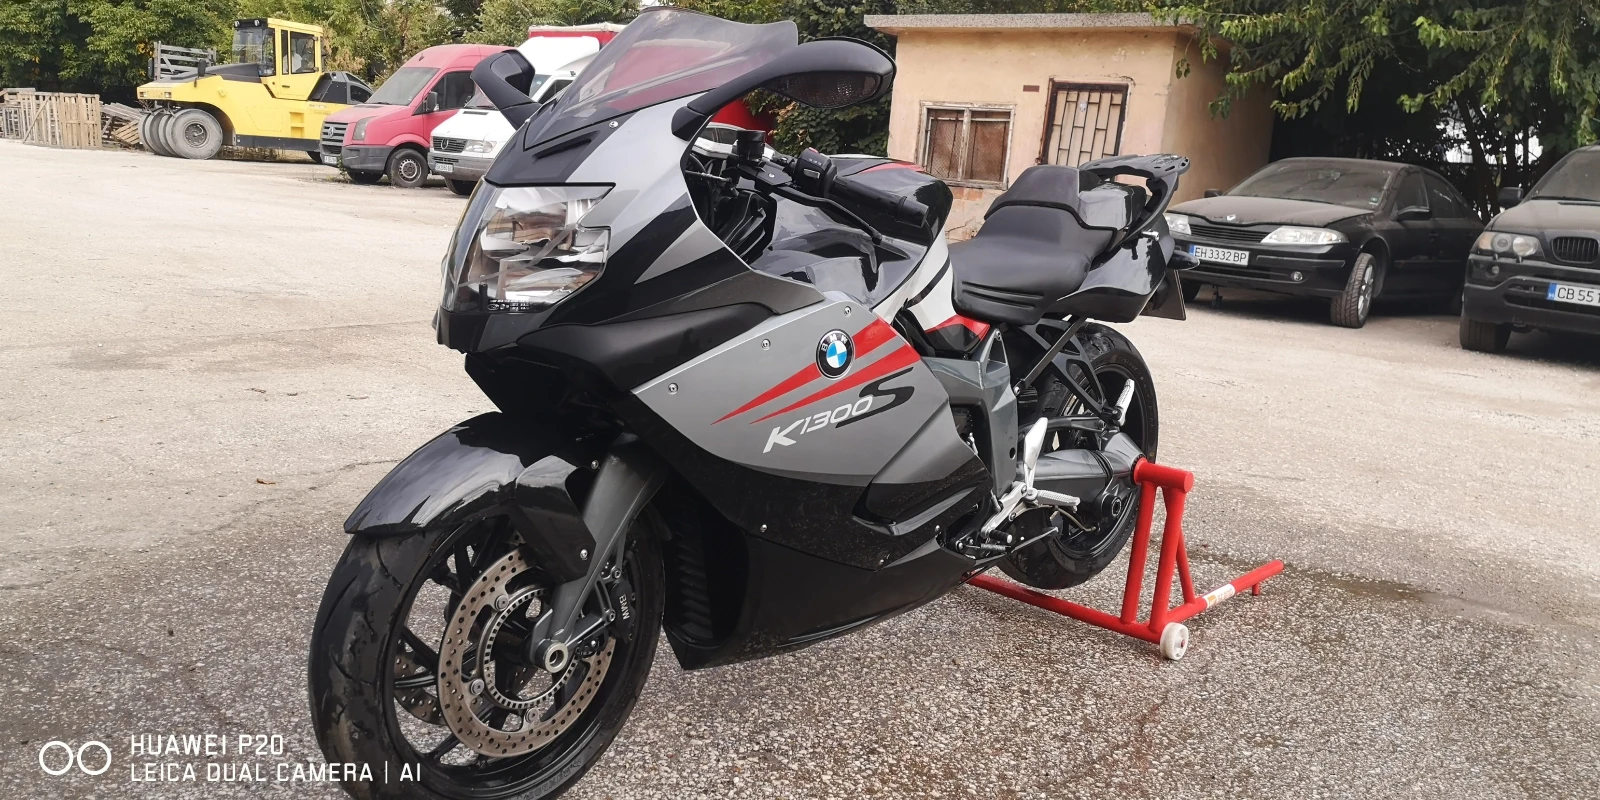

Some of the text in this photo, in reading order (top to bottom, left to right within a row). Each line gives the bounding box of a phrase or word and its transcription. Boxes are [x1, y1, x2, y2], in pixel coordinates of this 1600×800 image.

[1557, 287, 1575, 300] CB
[1577, 289, 1595, 303] 55
[619, 593, 630, 620] BMW
